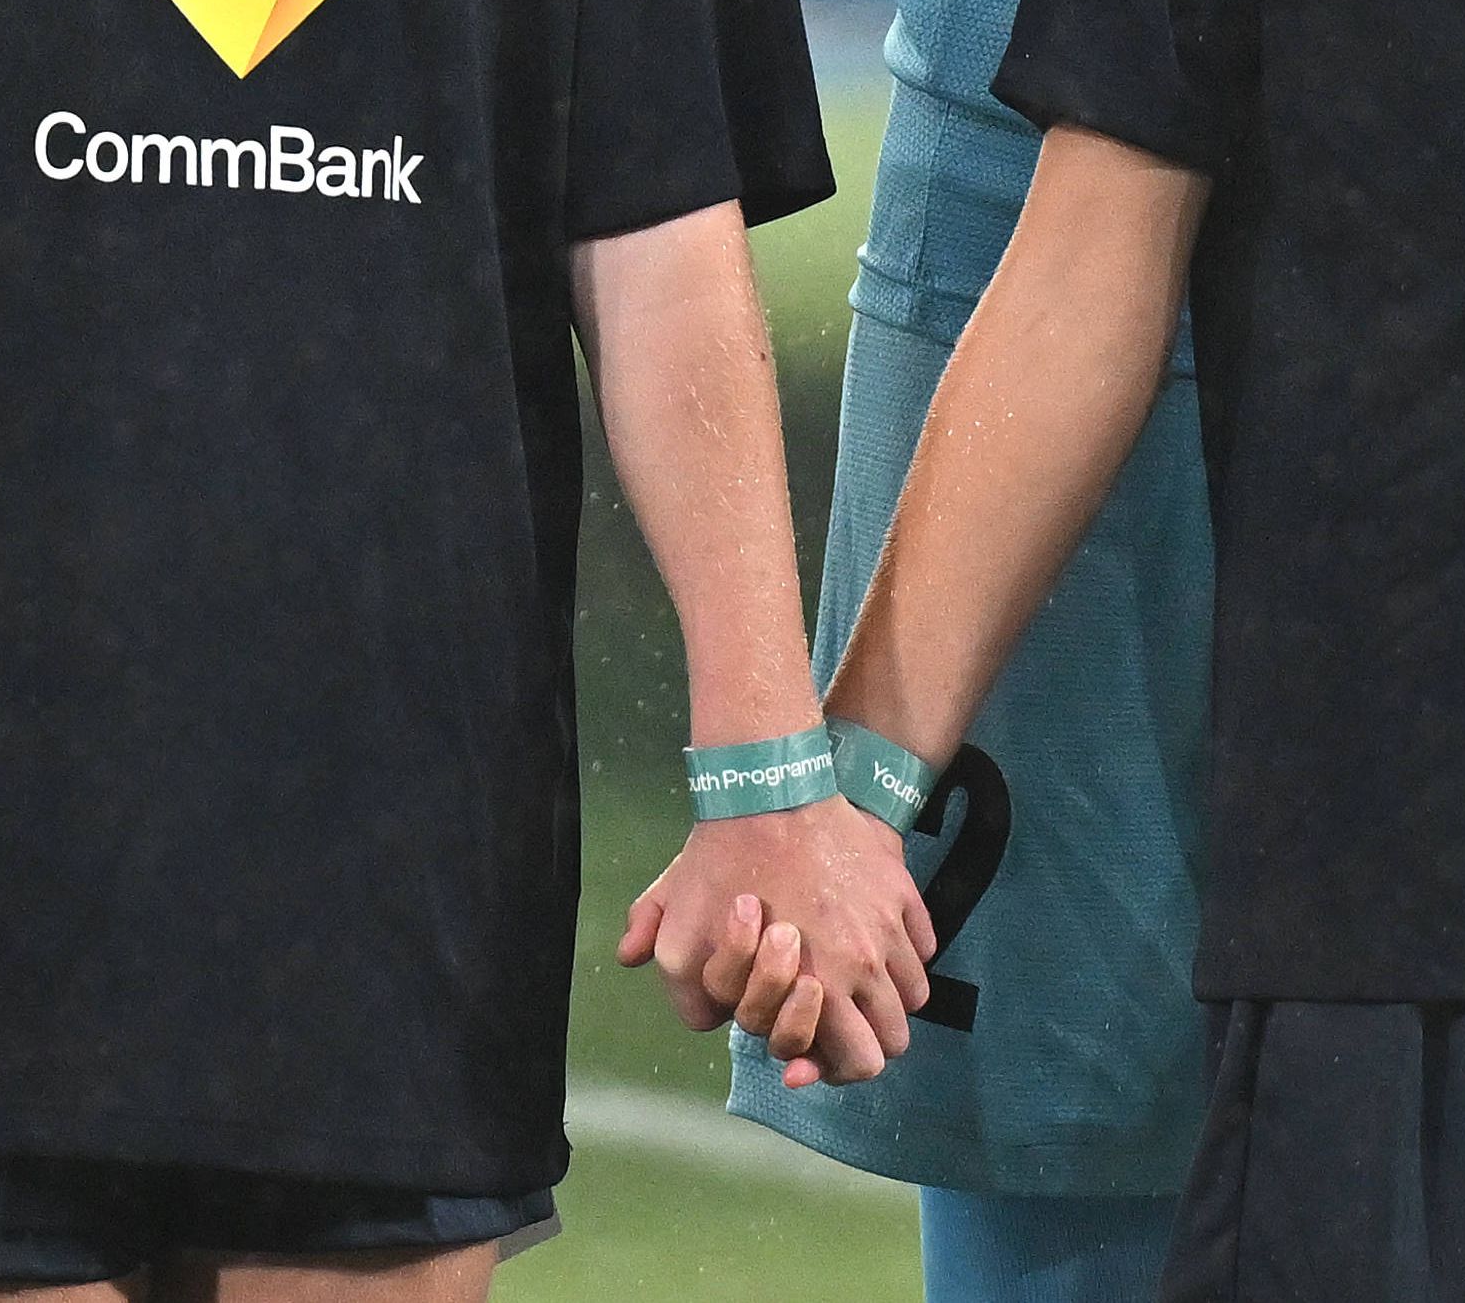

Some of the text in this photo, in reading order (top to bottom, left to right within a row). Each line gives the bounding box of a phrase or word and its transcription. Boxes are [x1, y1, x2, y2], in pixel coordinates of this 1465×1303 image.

[34, 111, 425, 205] CommBank
[872, 760, 922, 809] Youth
[908, 742, 1013, 1035] 2
